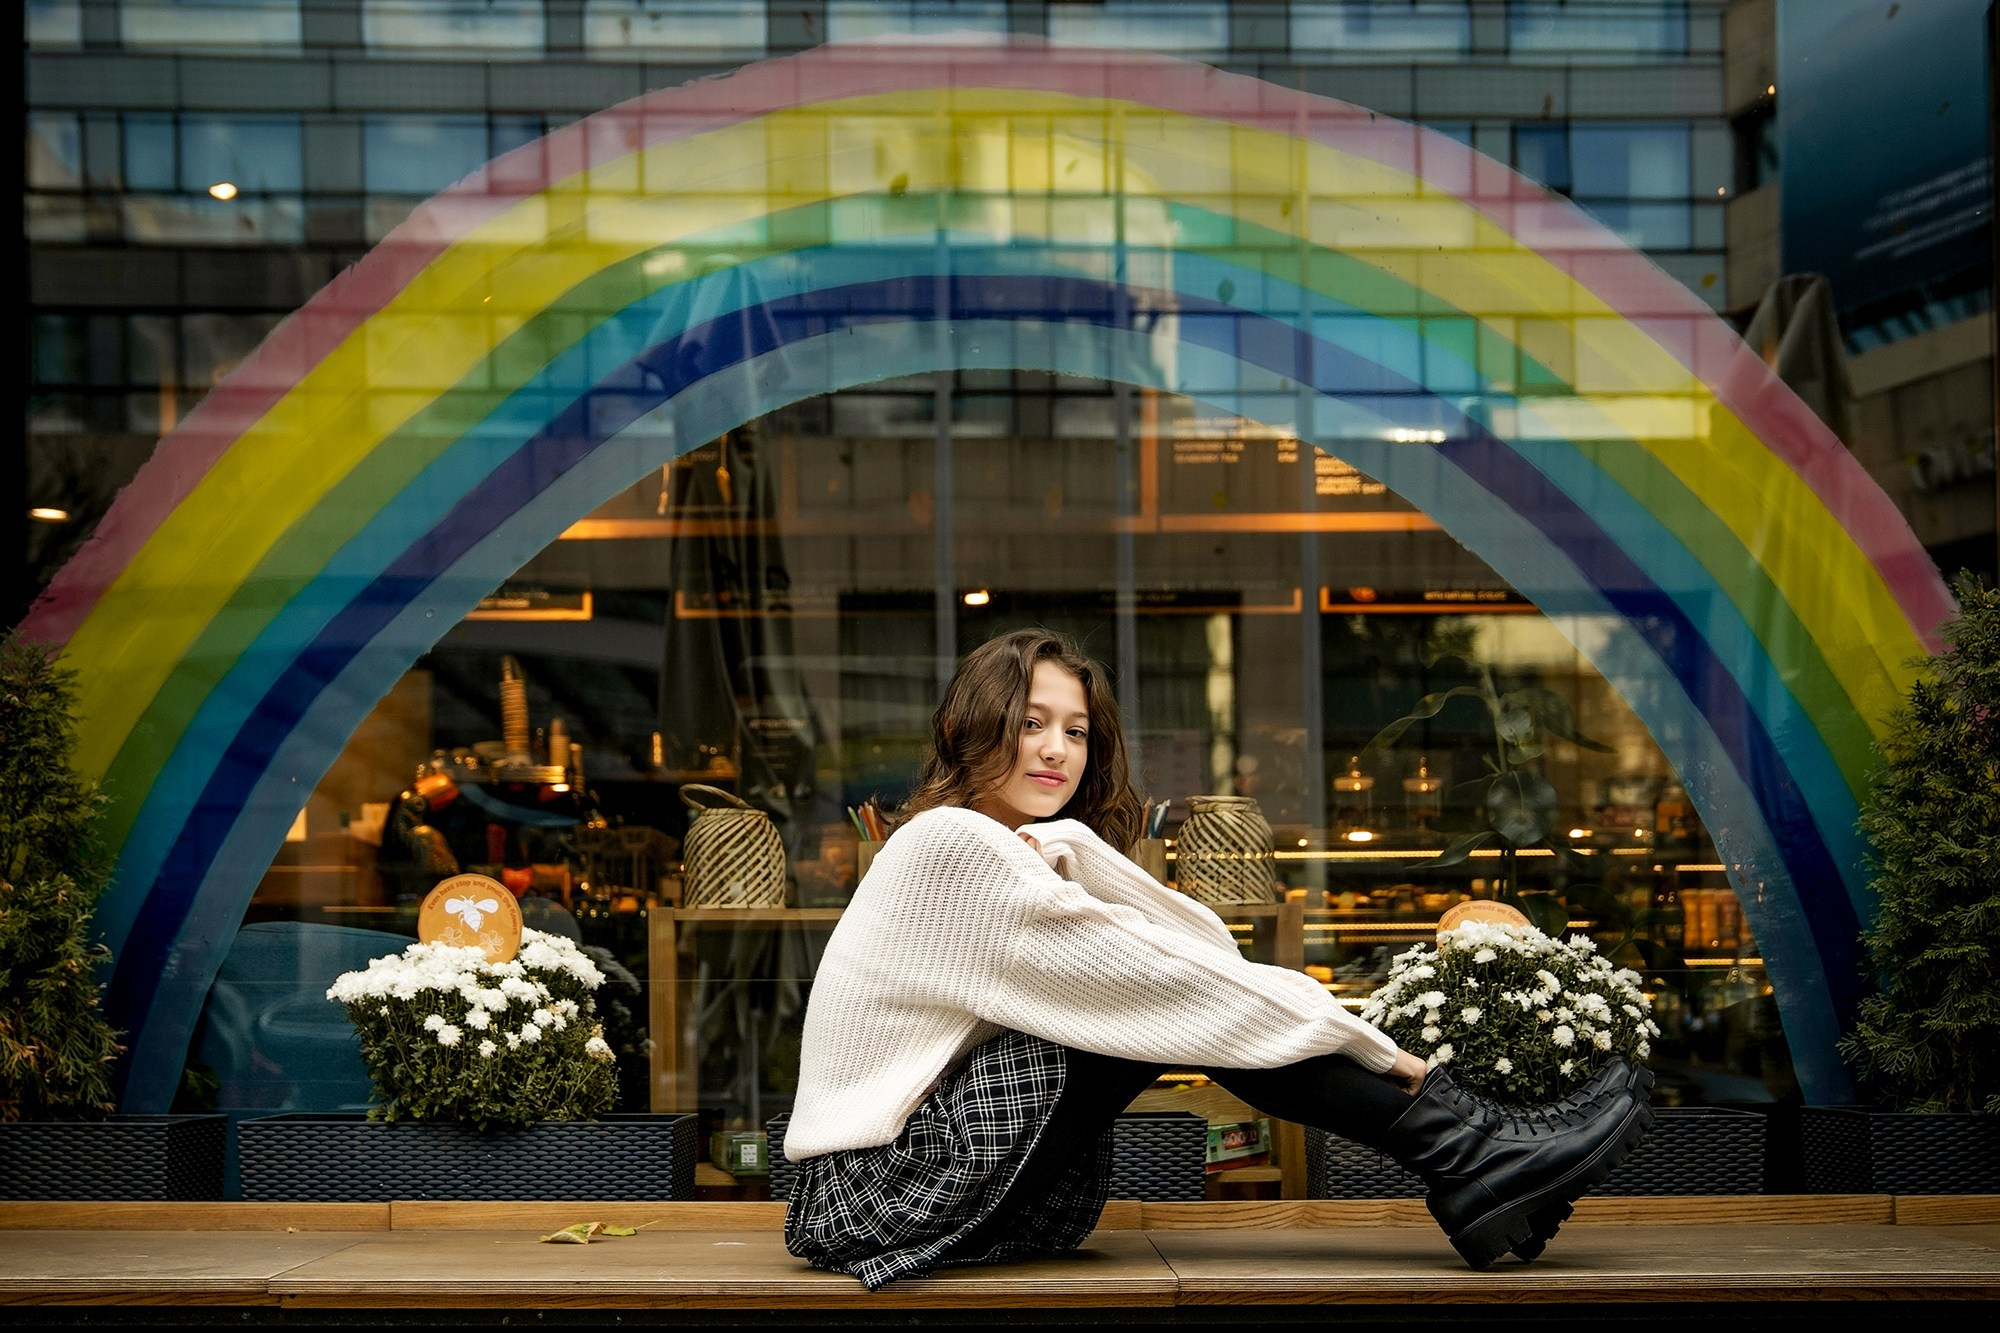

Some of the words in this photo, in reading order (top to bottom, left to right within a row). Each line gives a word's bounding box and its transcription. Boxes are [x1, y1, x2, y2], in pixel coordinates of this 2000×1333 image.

[427, 895, 441, 910] Even
[439, 884, 455, 896] bees
[455, 880, 472, 888] stop
[472, 880, 486, 888] and
[486, 884, 505, 898] smell
[502, 896, 512, 909] the
[1459, 905, 1471, 914] the
